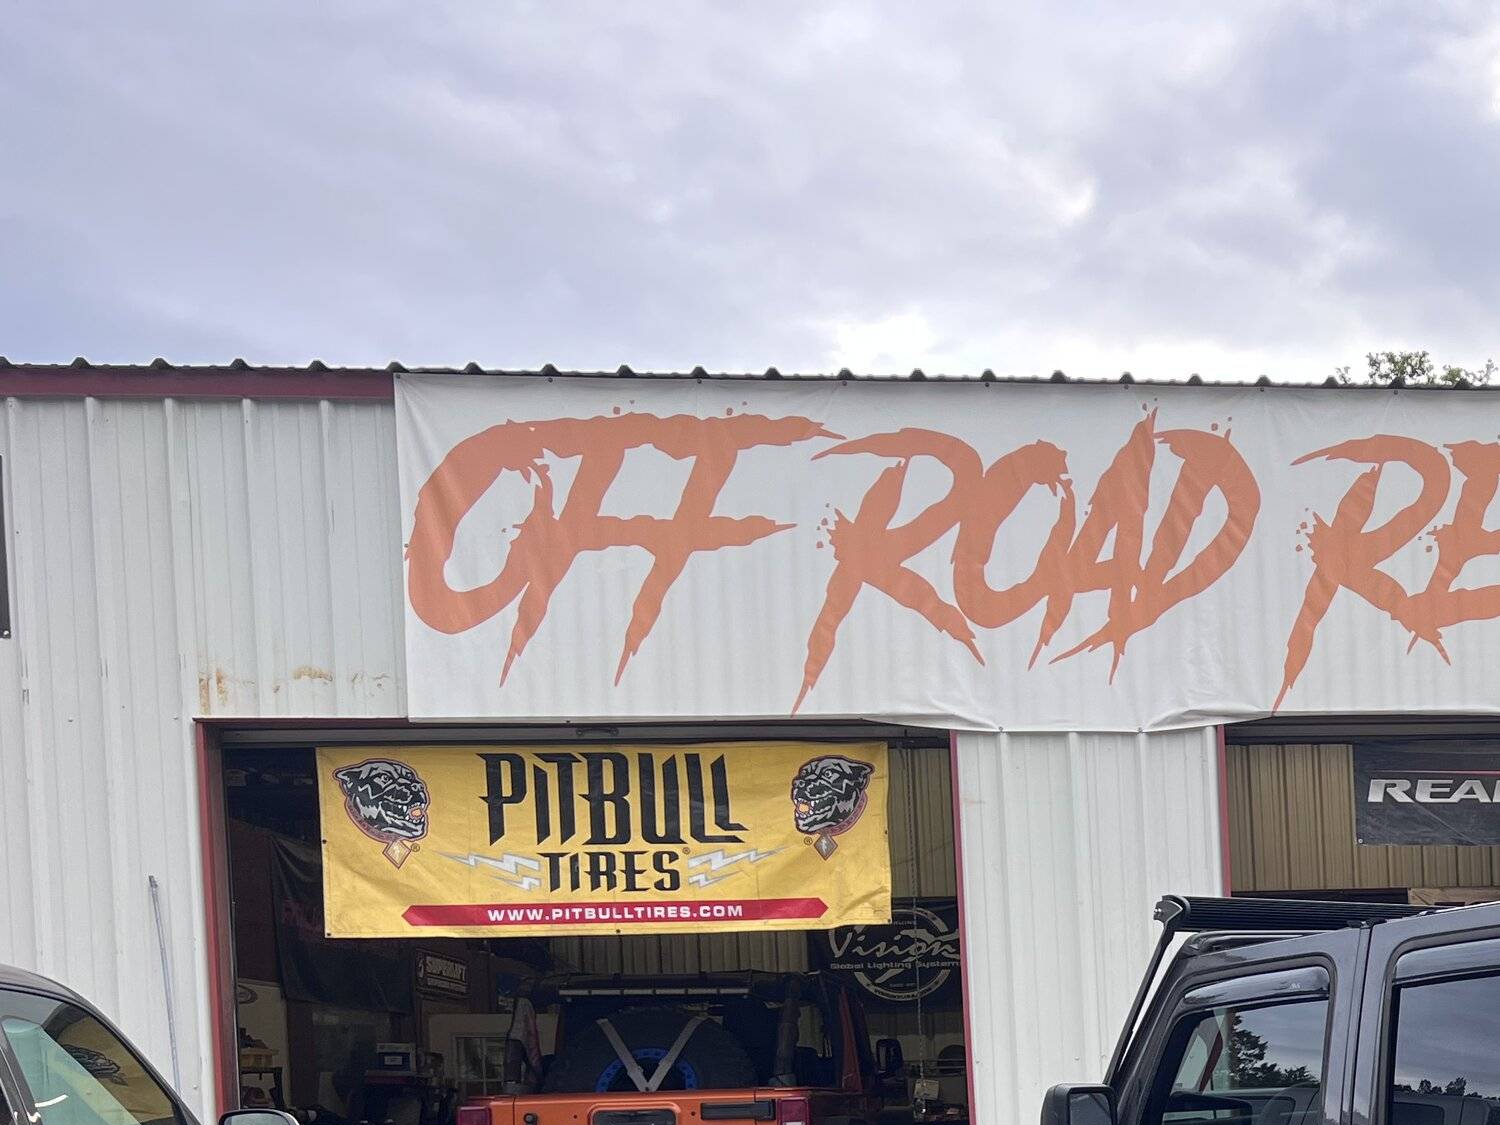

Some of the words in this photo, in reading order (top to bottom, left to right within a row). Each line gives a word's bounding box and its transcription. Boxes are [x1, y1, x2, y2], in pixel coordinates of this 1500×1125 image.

[405, 402, 844, 689] OFF
[791, 402, 1262, 716] ROAD
[476, 752, 749, 846] PITBULL
[537, 850, 681, 893] TIRES
[487, 905, 744, 922] WWW.PITBULLTIRES.COM
